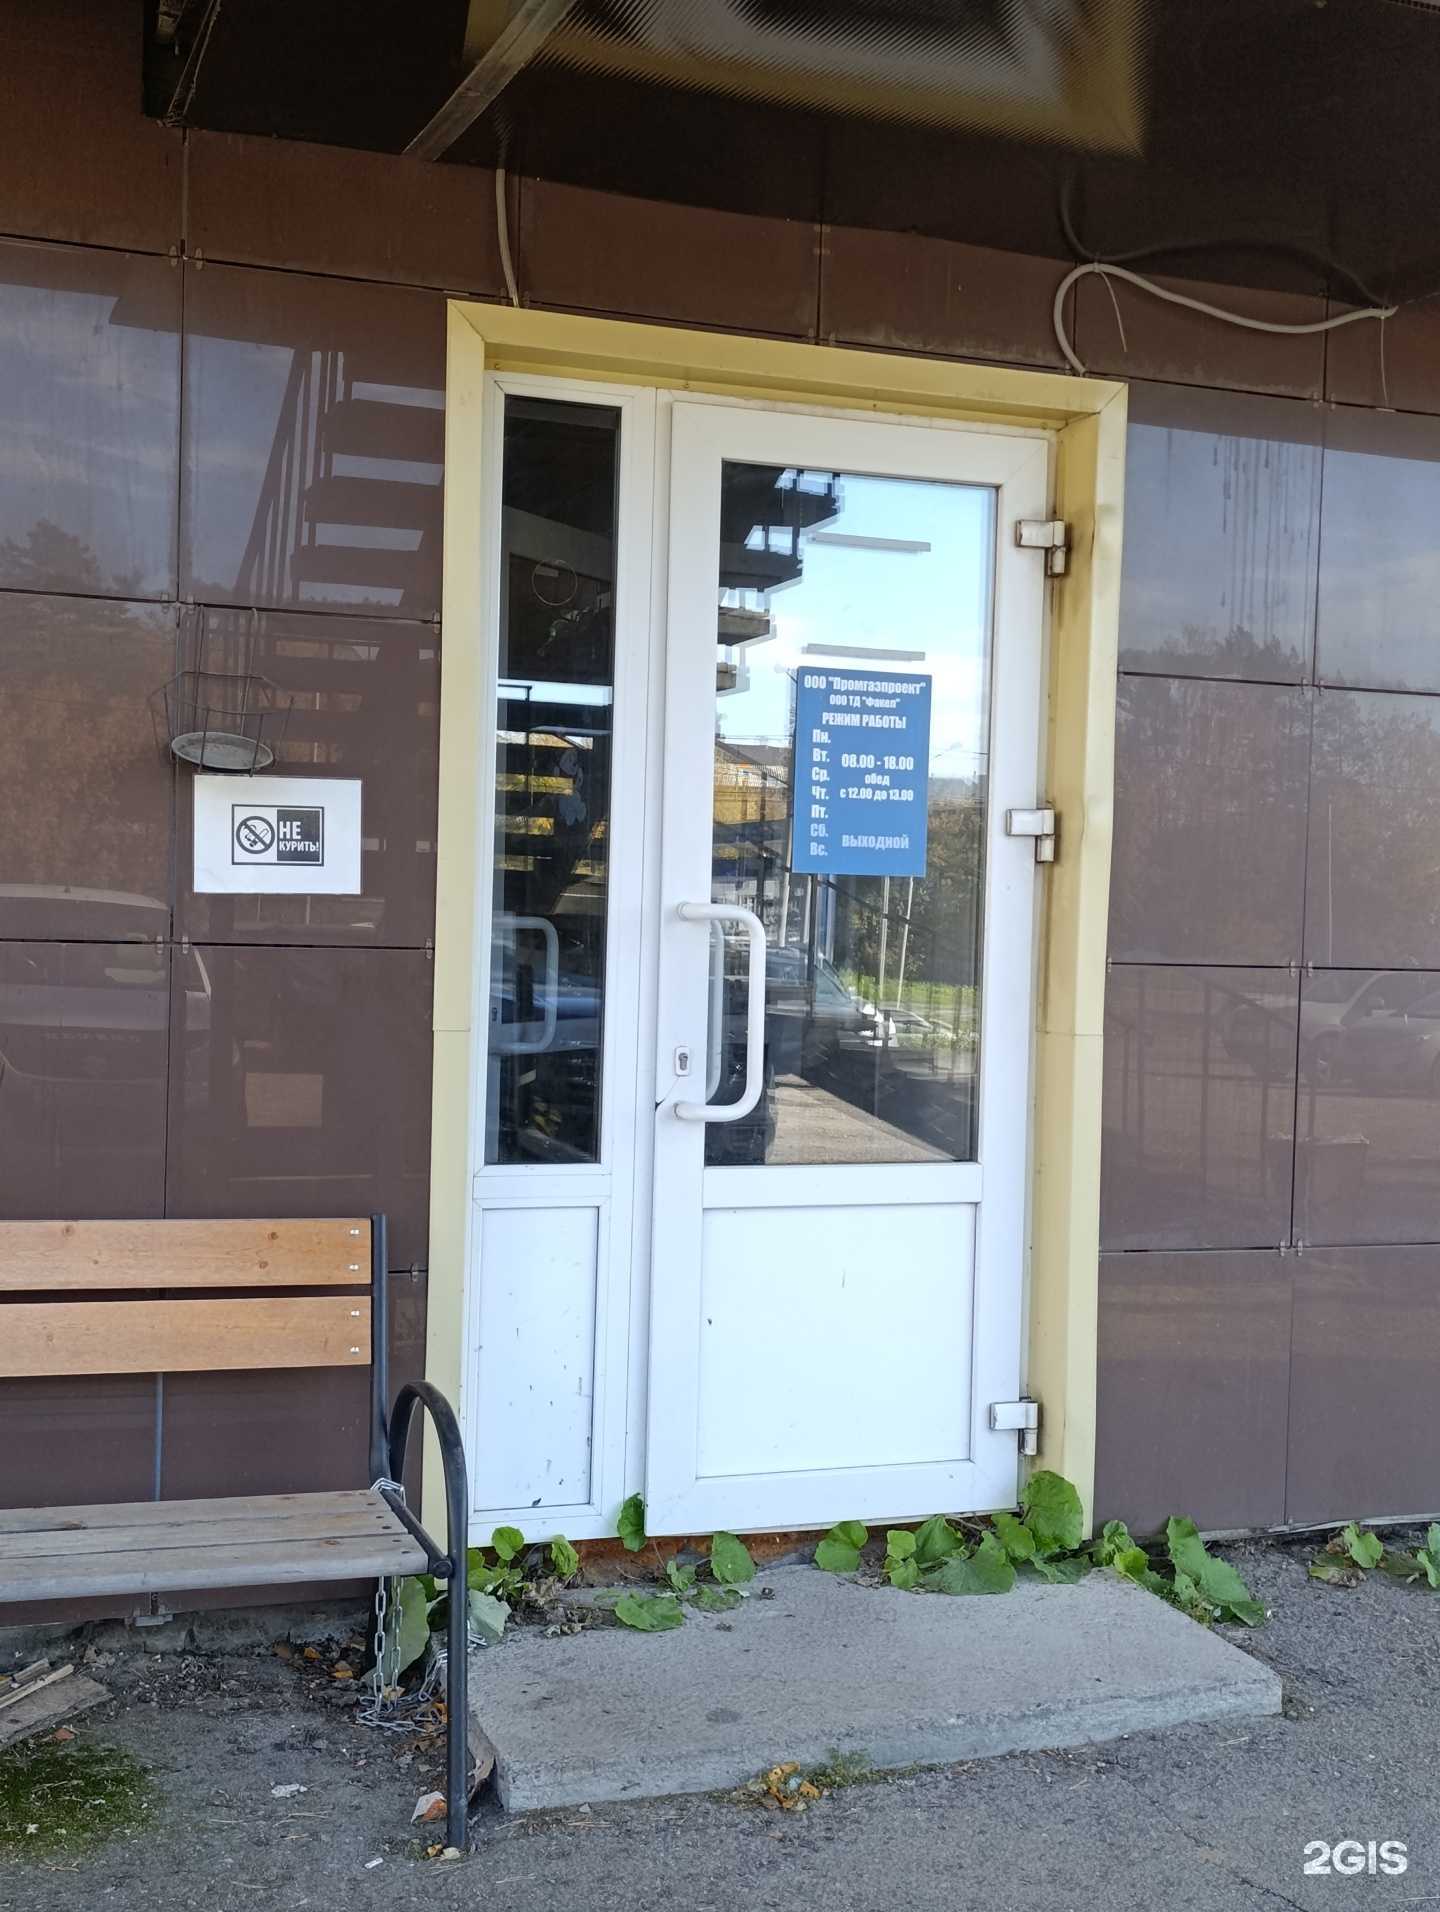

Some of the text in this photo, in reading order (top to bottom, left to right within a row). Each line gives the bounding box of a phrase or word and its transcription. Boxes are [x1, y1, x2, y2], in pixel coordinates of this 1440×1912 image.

[804, 675, 826, 689] ООО
[830, 694, 848, 705] ООО
[849, 696, 860, 707] ТД
[822, 714, 907, 729] РЕЖИМ РАБОТЫ
[812, 729, 831, 743] Пн.
[813, 748, 830, 762] Вт.
[841, 754, 875, 768] 08.00
[884, 756, 914, 770] 18.00
[812, 767, 830, 783] Ср.
[864, 773, 890, 785] обед
[811, 786, 829, 800] Чт.
[849, 789, 872, 800] 12.00
[874, 791, 887, 801] до
[889, 790, 914, 801] 13.00
[811, 805, 829, 818] Пт.
[279, 821, 301, 839] НЕ
[810, 824, 829, 837] Сб.
[279, 841, 319, 852] КУРИТЬ!
[810, 842, 828, 856] Вс.
[842, 834, 909, 850] ВЫХОДНОЙ
